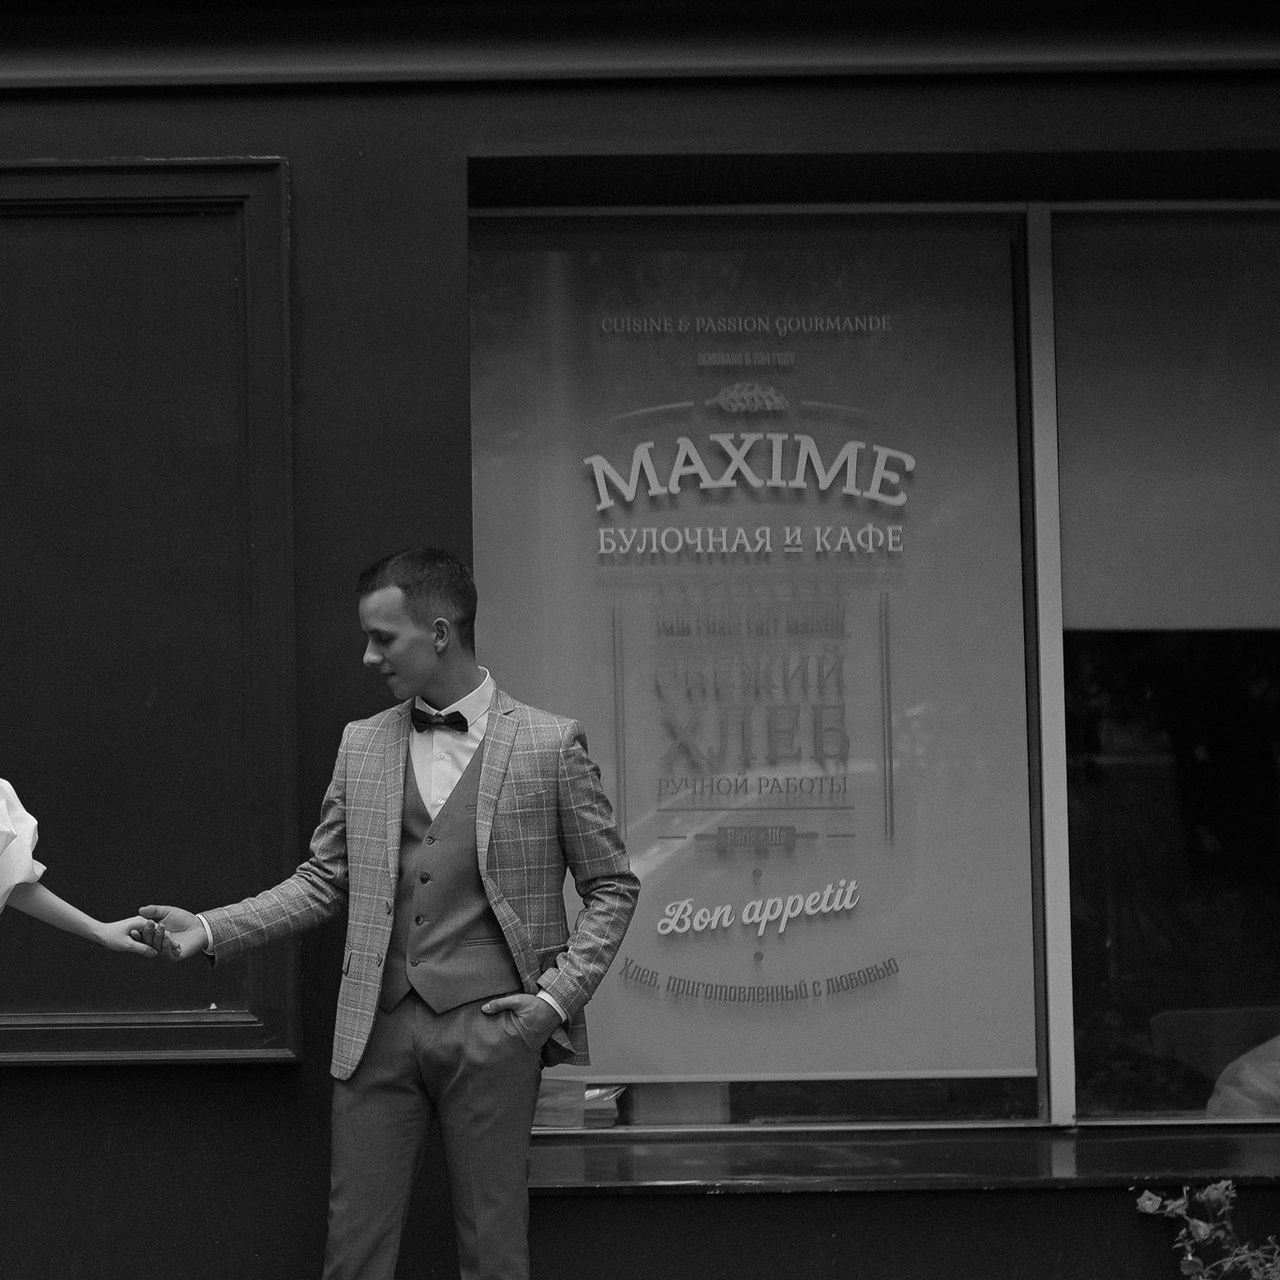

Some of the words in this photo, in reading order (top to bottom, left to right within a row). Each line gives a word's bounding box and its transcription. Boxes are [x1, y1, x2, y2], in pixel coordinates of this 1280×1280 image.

[601, 315, 674, 334] CUISINE
[678, 317, 691, 333] &
[695, 315, 771, 334] PASSION
[775, 314, 892, 337] GOURMANDE
[583, 431, 916, 513] MAXIME
[598, 526, 772, 556] БУЛОЧНАЯ
[815, 523, 904, 553] КАФЕ
[657, 771, 749, 797] РУЧНОЙ
[757, 775, 848, 795] РАБОТЫ
[657, 897, 736, 935] Bon
[742, 878, 861, 937] appetit
[665, 975, 809, 1003] приготовленный
[825, 956, 900, 995] любовью
